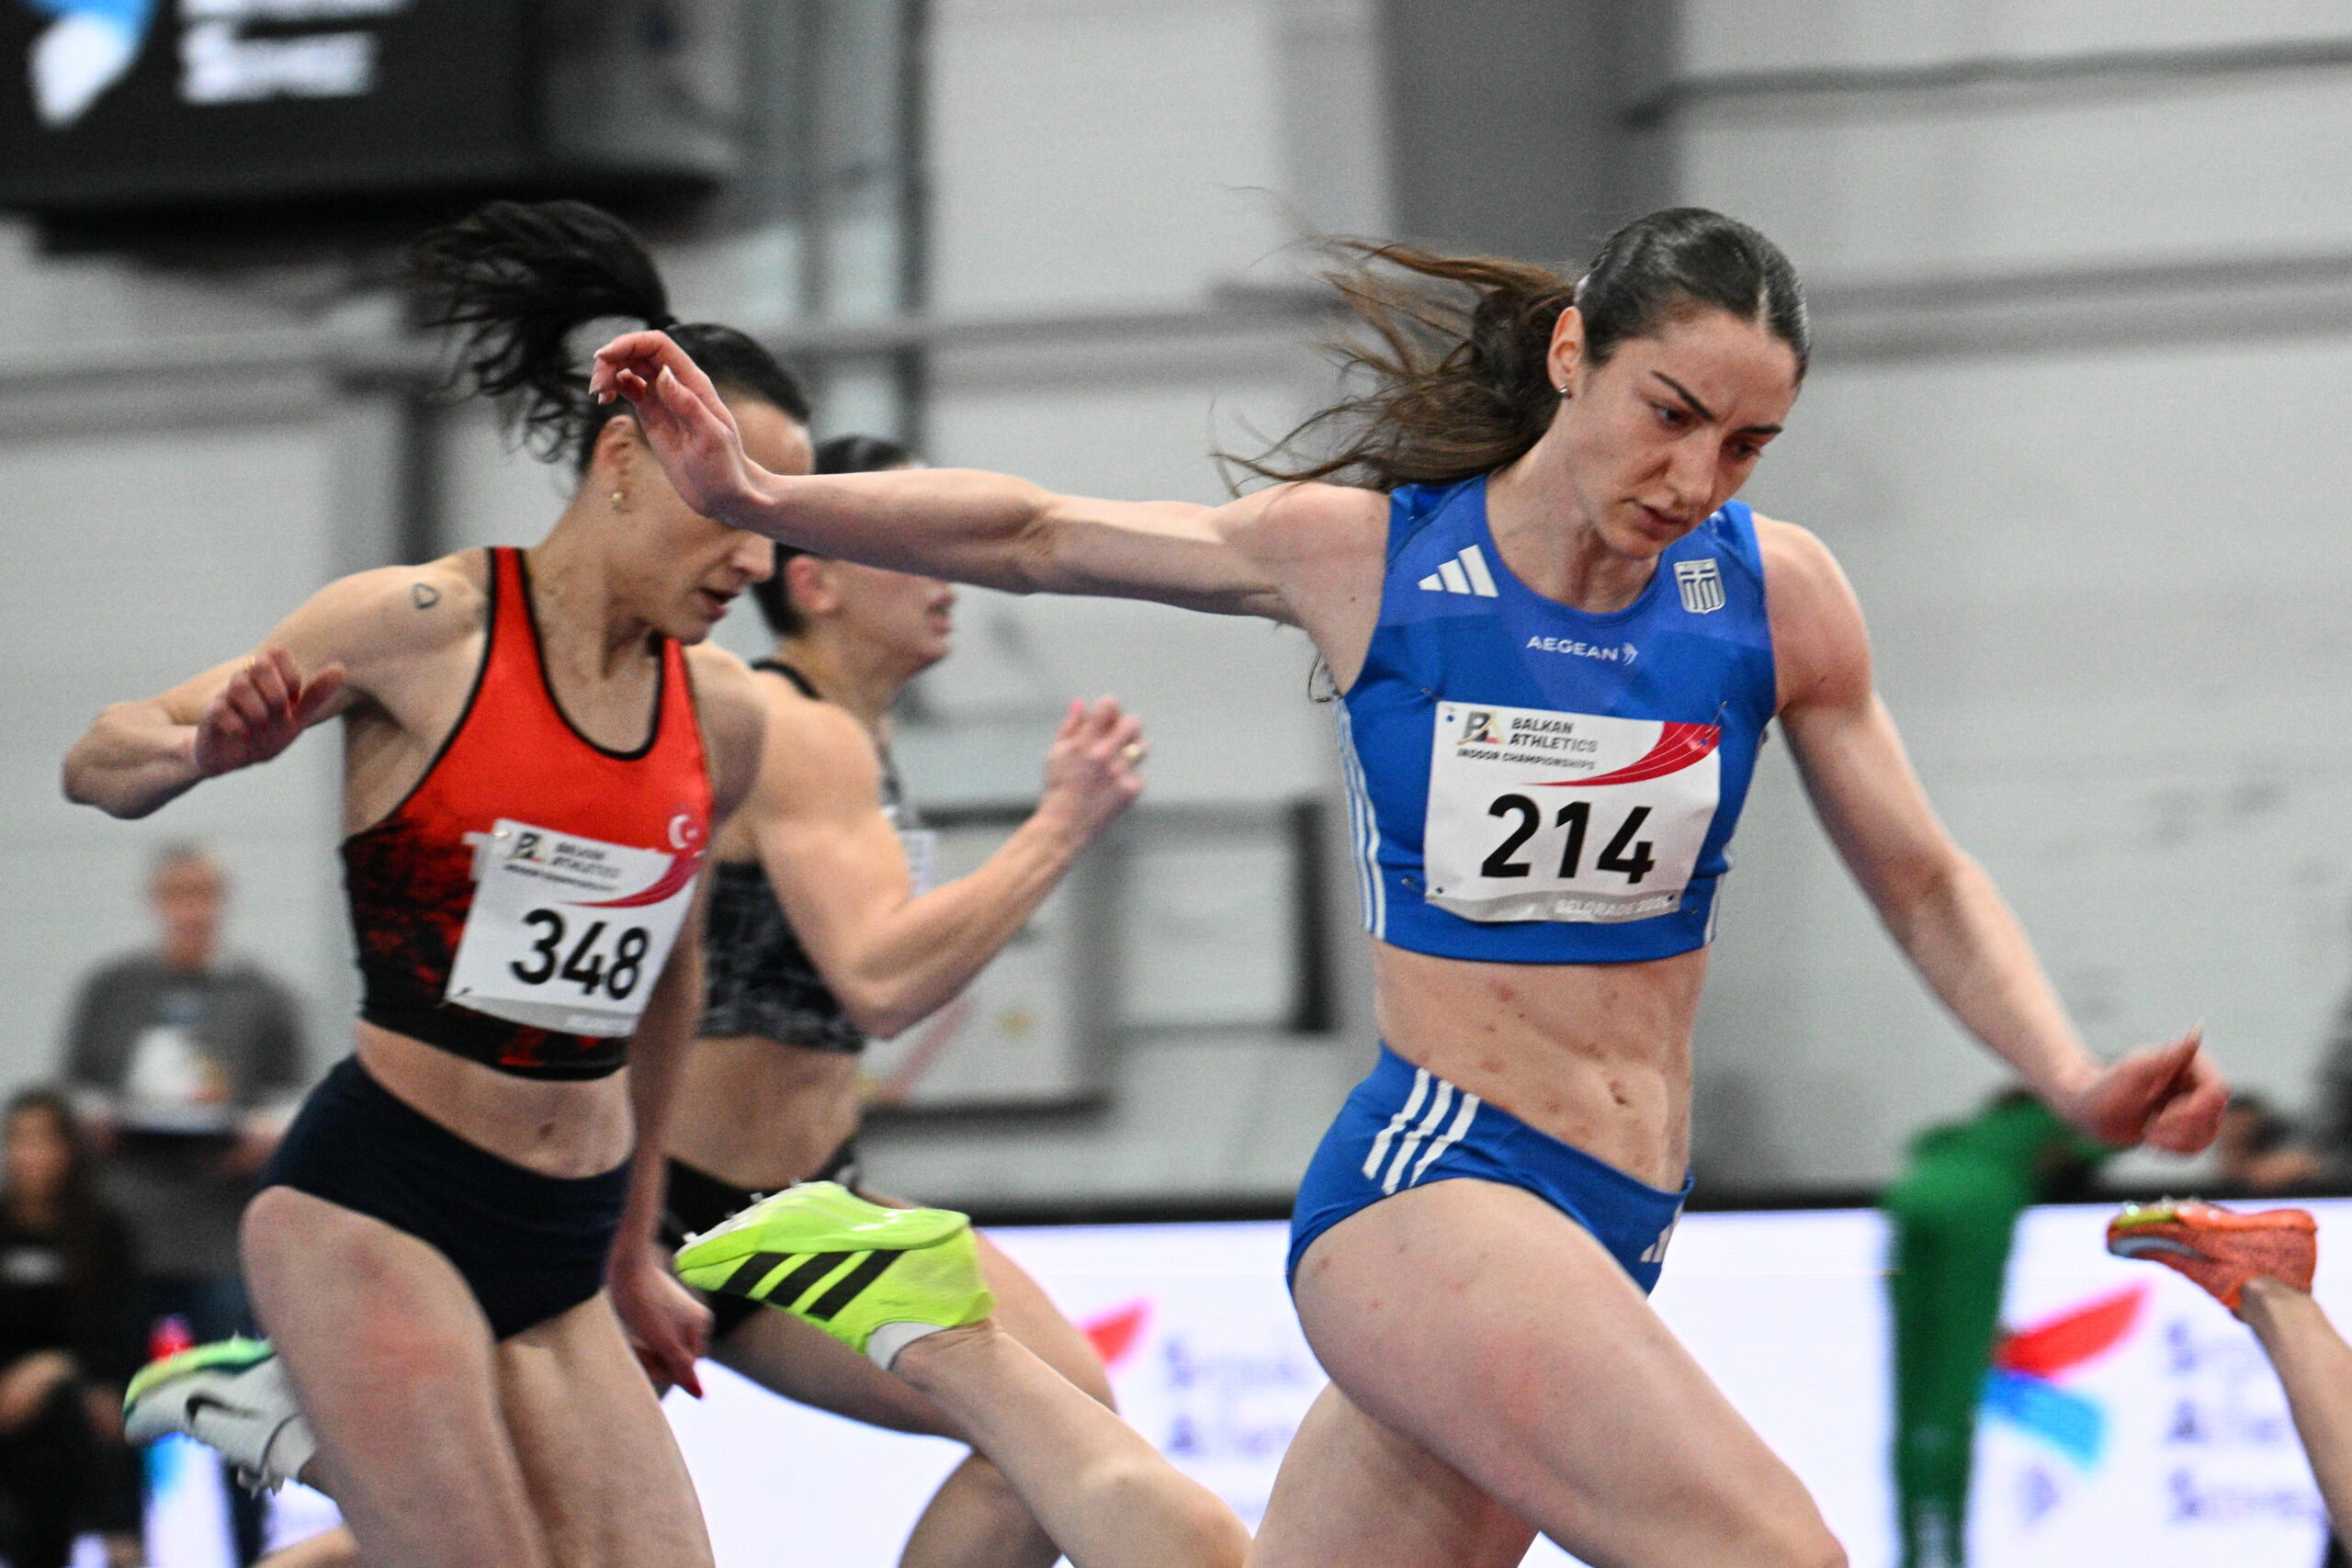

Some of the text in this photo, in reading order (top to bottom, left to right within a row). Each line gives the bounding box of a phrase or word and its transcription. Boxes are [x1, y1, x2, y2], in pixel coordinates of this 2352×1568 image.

[1526, 636, 1619, 661] AEGEAN
[1511, 717, 1574, 734] BALKAN
[1510, 733, 1599, 752] ATHLETICS
[1456, 749, 1596, 771] INDOOR CHAMPIONSHIPS
[1480, 794, 1657, 884] 214
[510, 908, 650, 1000] 348
